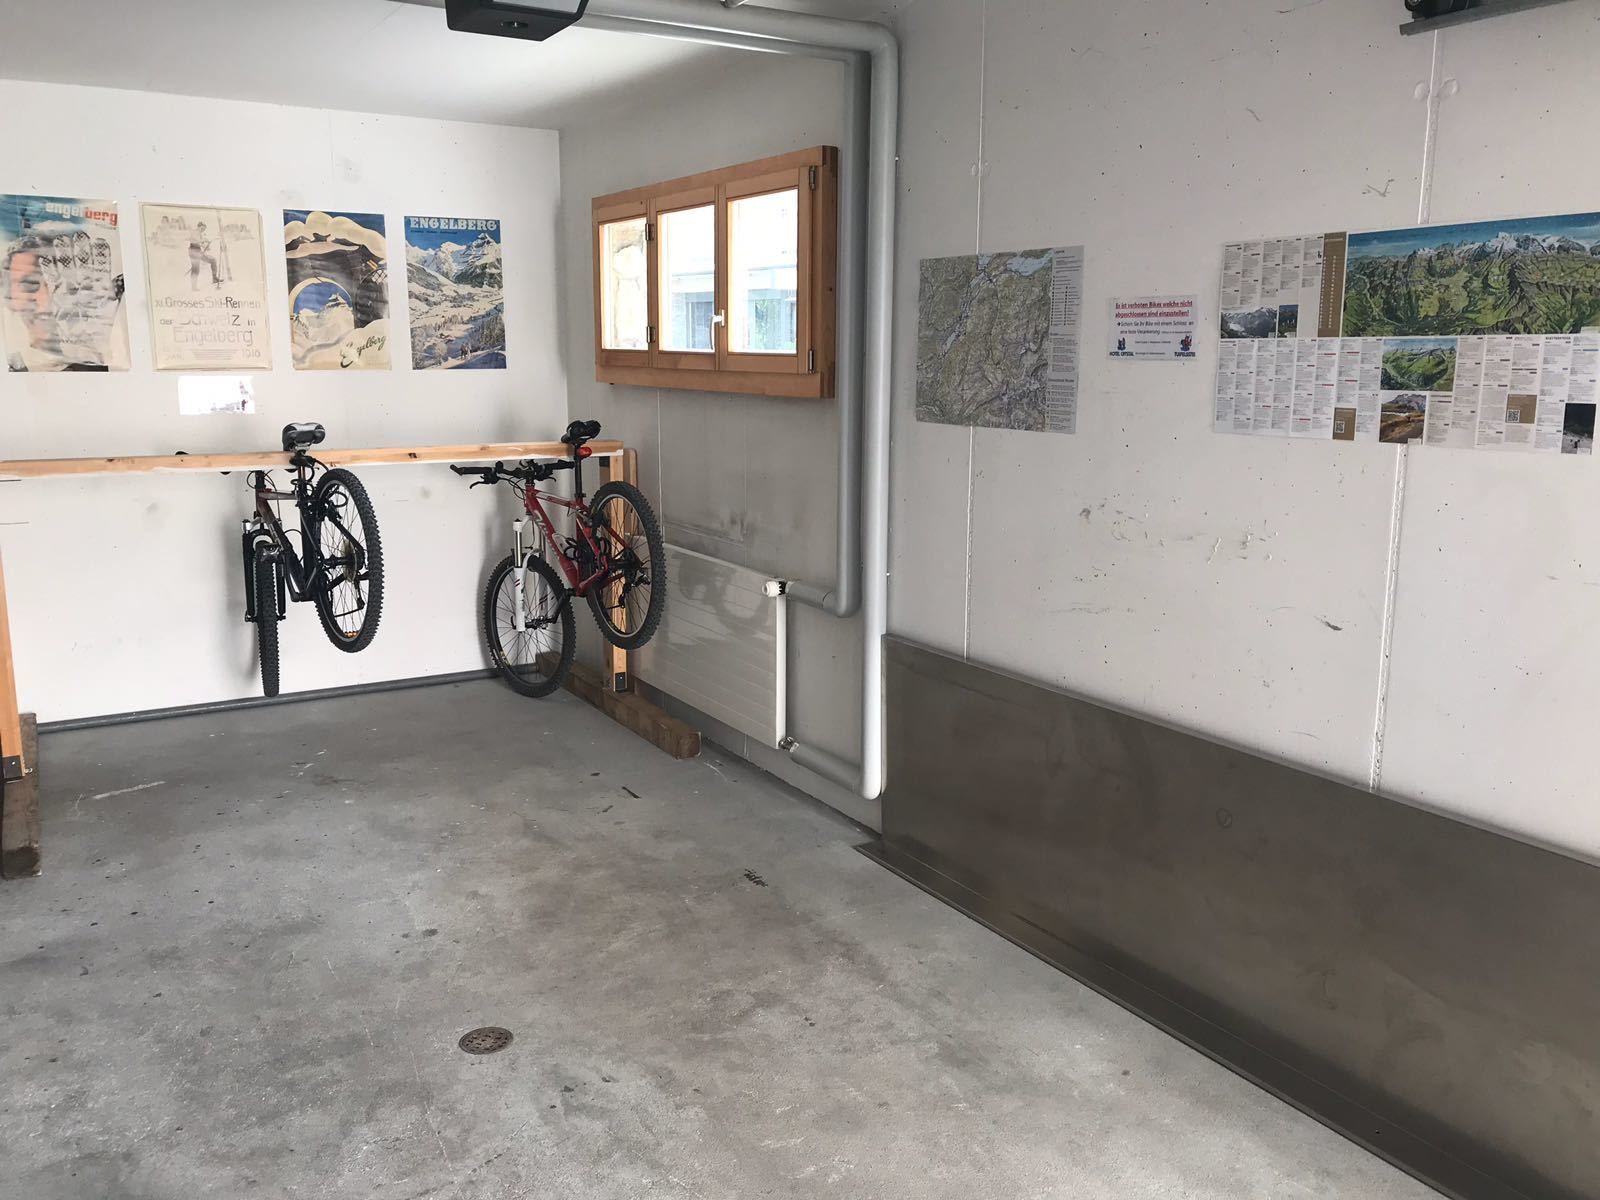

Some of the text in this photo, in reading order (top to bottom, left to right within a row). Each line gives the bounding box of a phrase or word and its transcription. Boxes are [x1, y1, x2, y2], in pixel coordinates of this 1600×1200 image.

[409, 217, 497, 231] ENGELBERG
[165, 297, 204, 309] Grosses
[1148, 301, 1161, 309] Bikes
[1179, 300, 1193, 308] nicht
[173, 326, 254, 347] Engelberg
